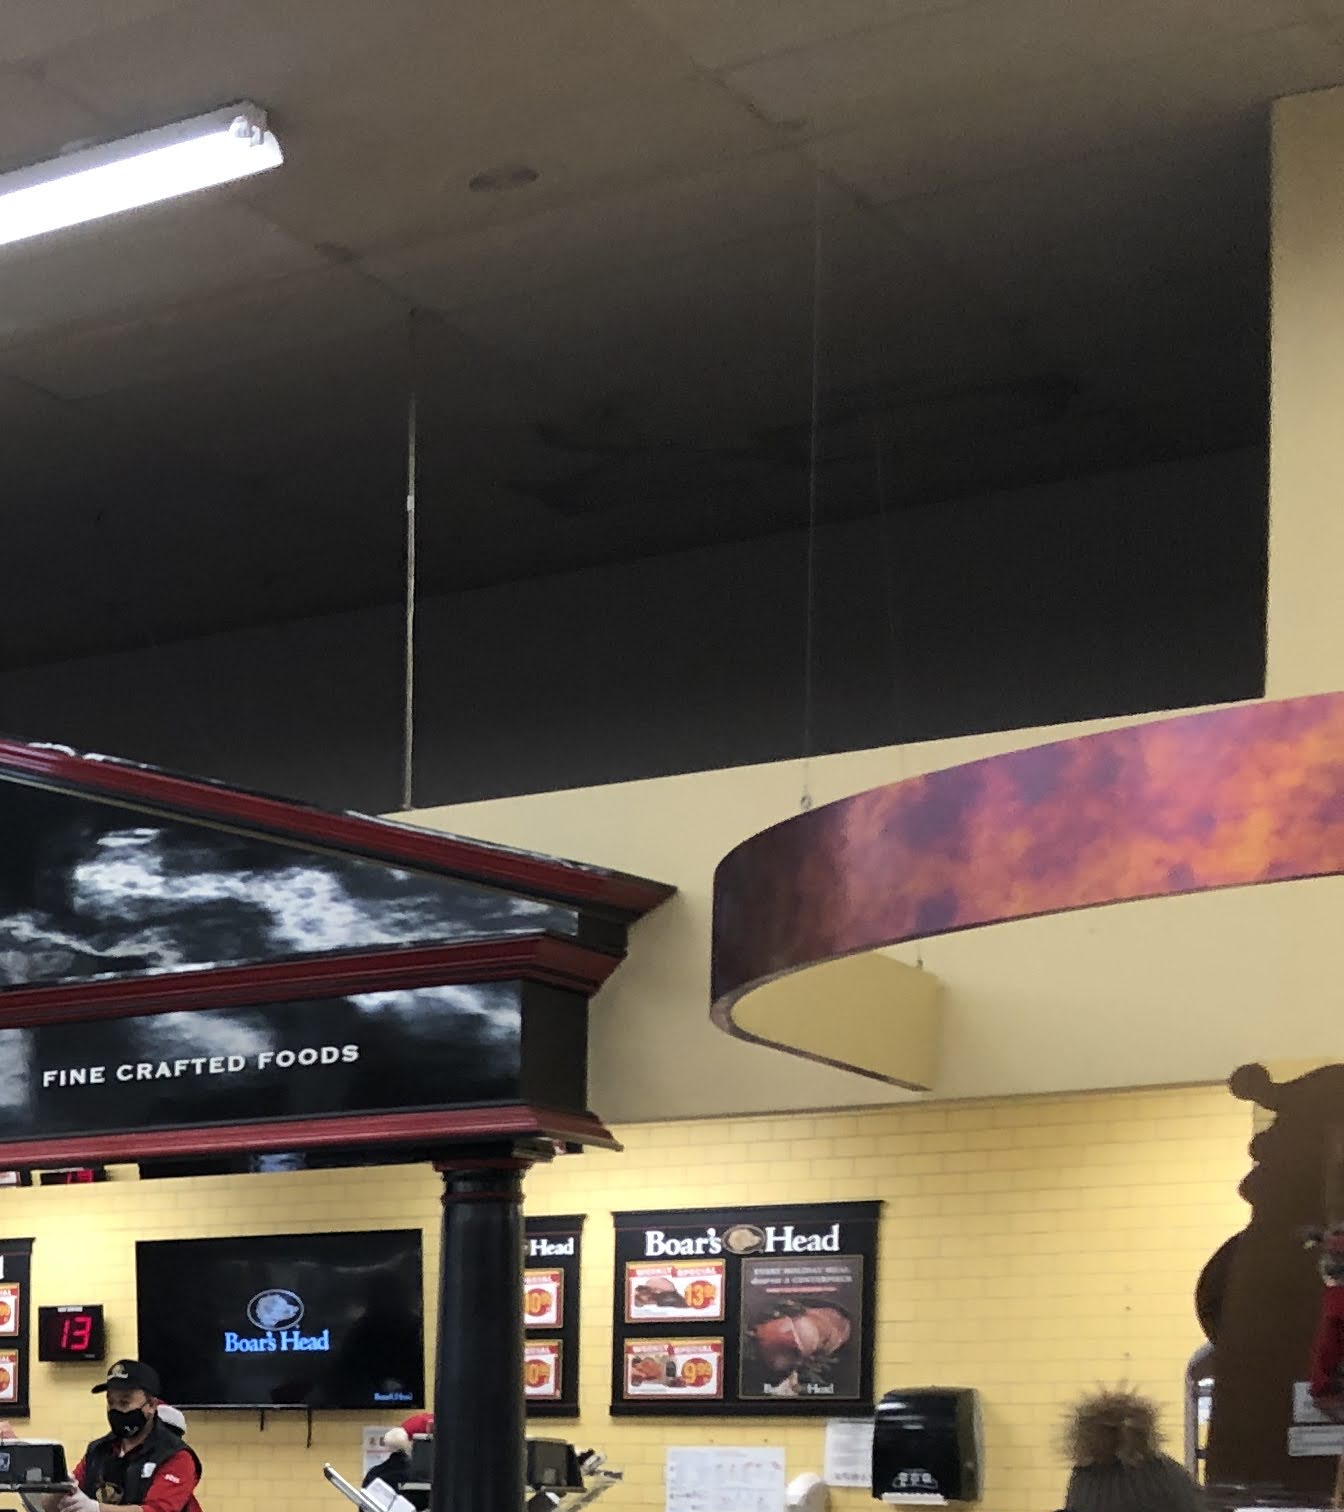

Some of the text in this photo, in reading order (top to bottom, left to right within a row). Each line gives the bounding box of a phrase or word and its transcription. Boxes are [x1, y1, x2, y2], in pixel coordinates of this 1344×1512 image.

[42, 1043, 360, 1088] FINE CRAFTED FOODS
[529, 1236, 575, 1257] Head
[644, 1223, 840, 1257] Boar's Head
[61, 1316, 93, 1350] 13
[224, 1328, 330, 1353] Boar's Head
